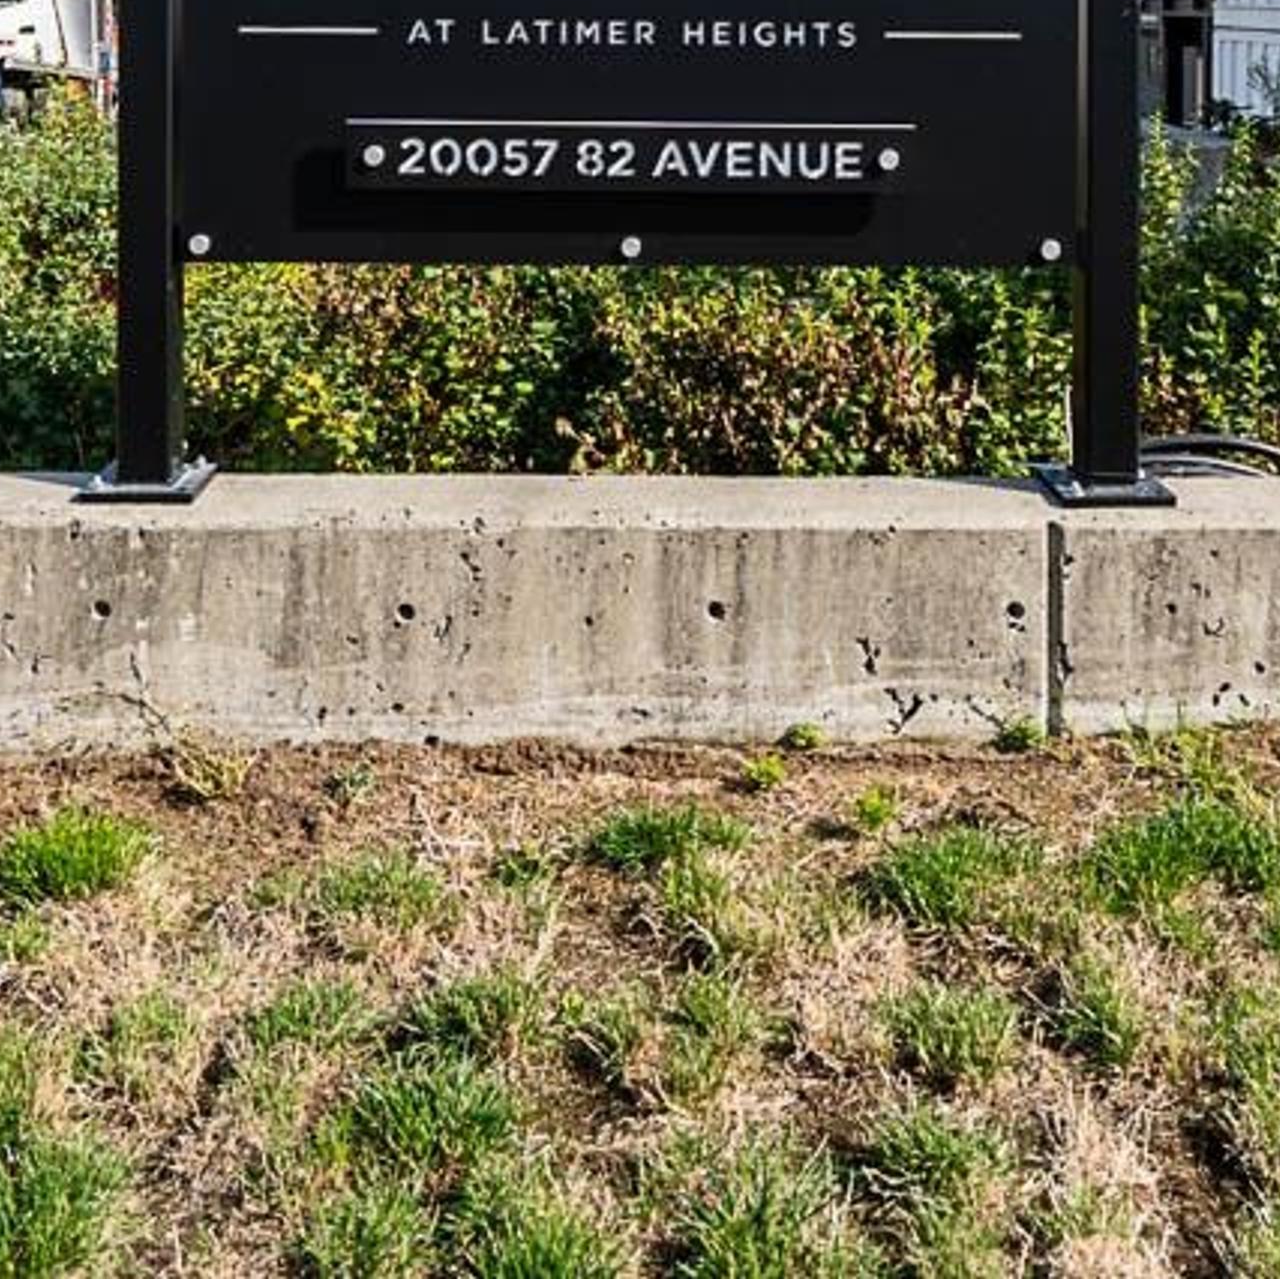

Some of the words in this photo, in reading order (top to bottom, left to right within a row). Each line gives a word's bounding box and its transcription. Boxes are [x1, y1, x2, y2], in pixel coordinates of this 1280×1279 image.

[406, 18, 456, 45] AT
[480, 19, 657, 46] LATIMER
[682, 20, 858, 48] HEIGHTS
[397, 137, 560, 177] 20057
[575, 139, 637, 177] 82
[651, 140, 864, 180] AVENUE
